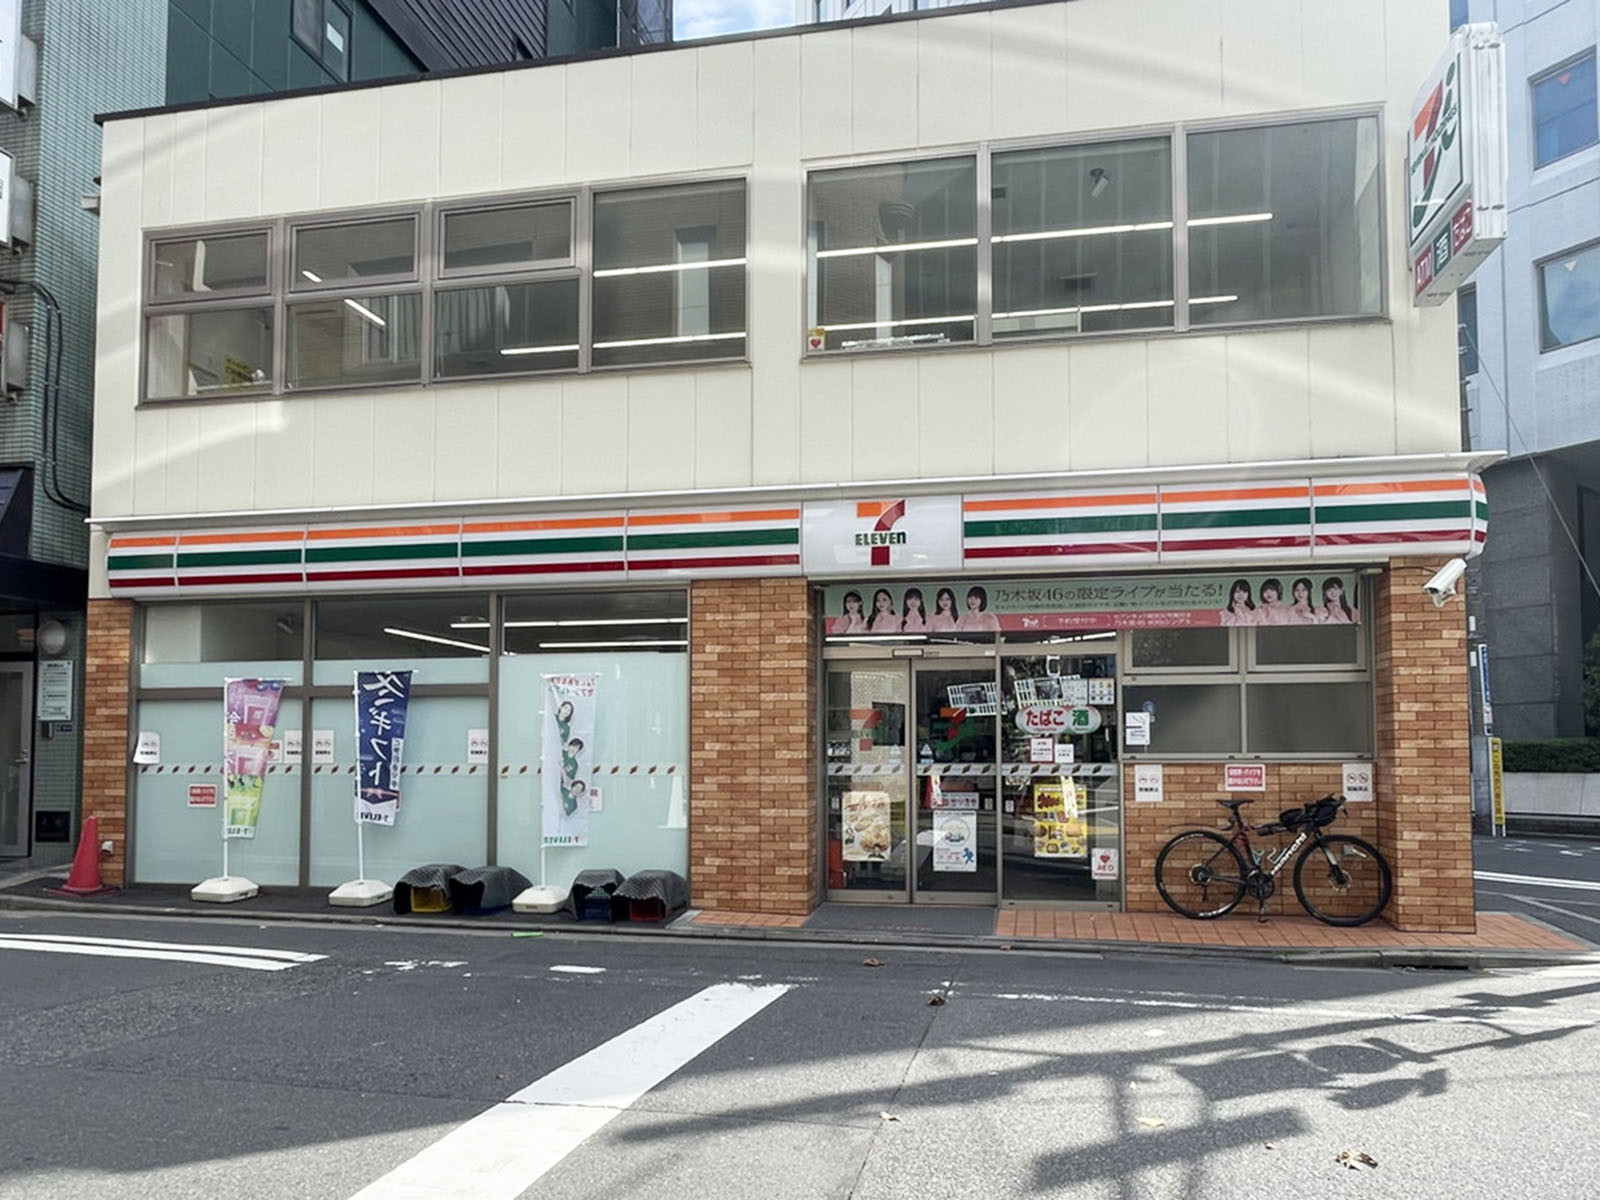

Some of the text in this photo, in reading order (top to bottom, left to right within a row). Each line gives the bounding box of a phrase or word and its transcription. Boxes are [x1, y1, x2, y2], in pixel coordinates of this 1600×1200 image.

[1453, 199, 1473, 248] たばこ
[1436, 231, 1450, 270] 酒
[1416, 251, 1432, 293] ATM
[1025, 709, 1065, 727] たばこ
[1072, 709, 1090, 727] 酒
[1096, 863, 1115, 872] AED
